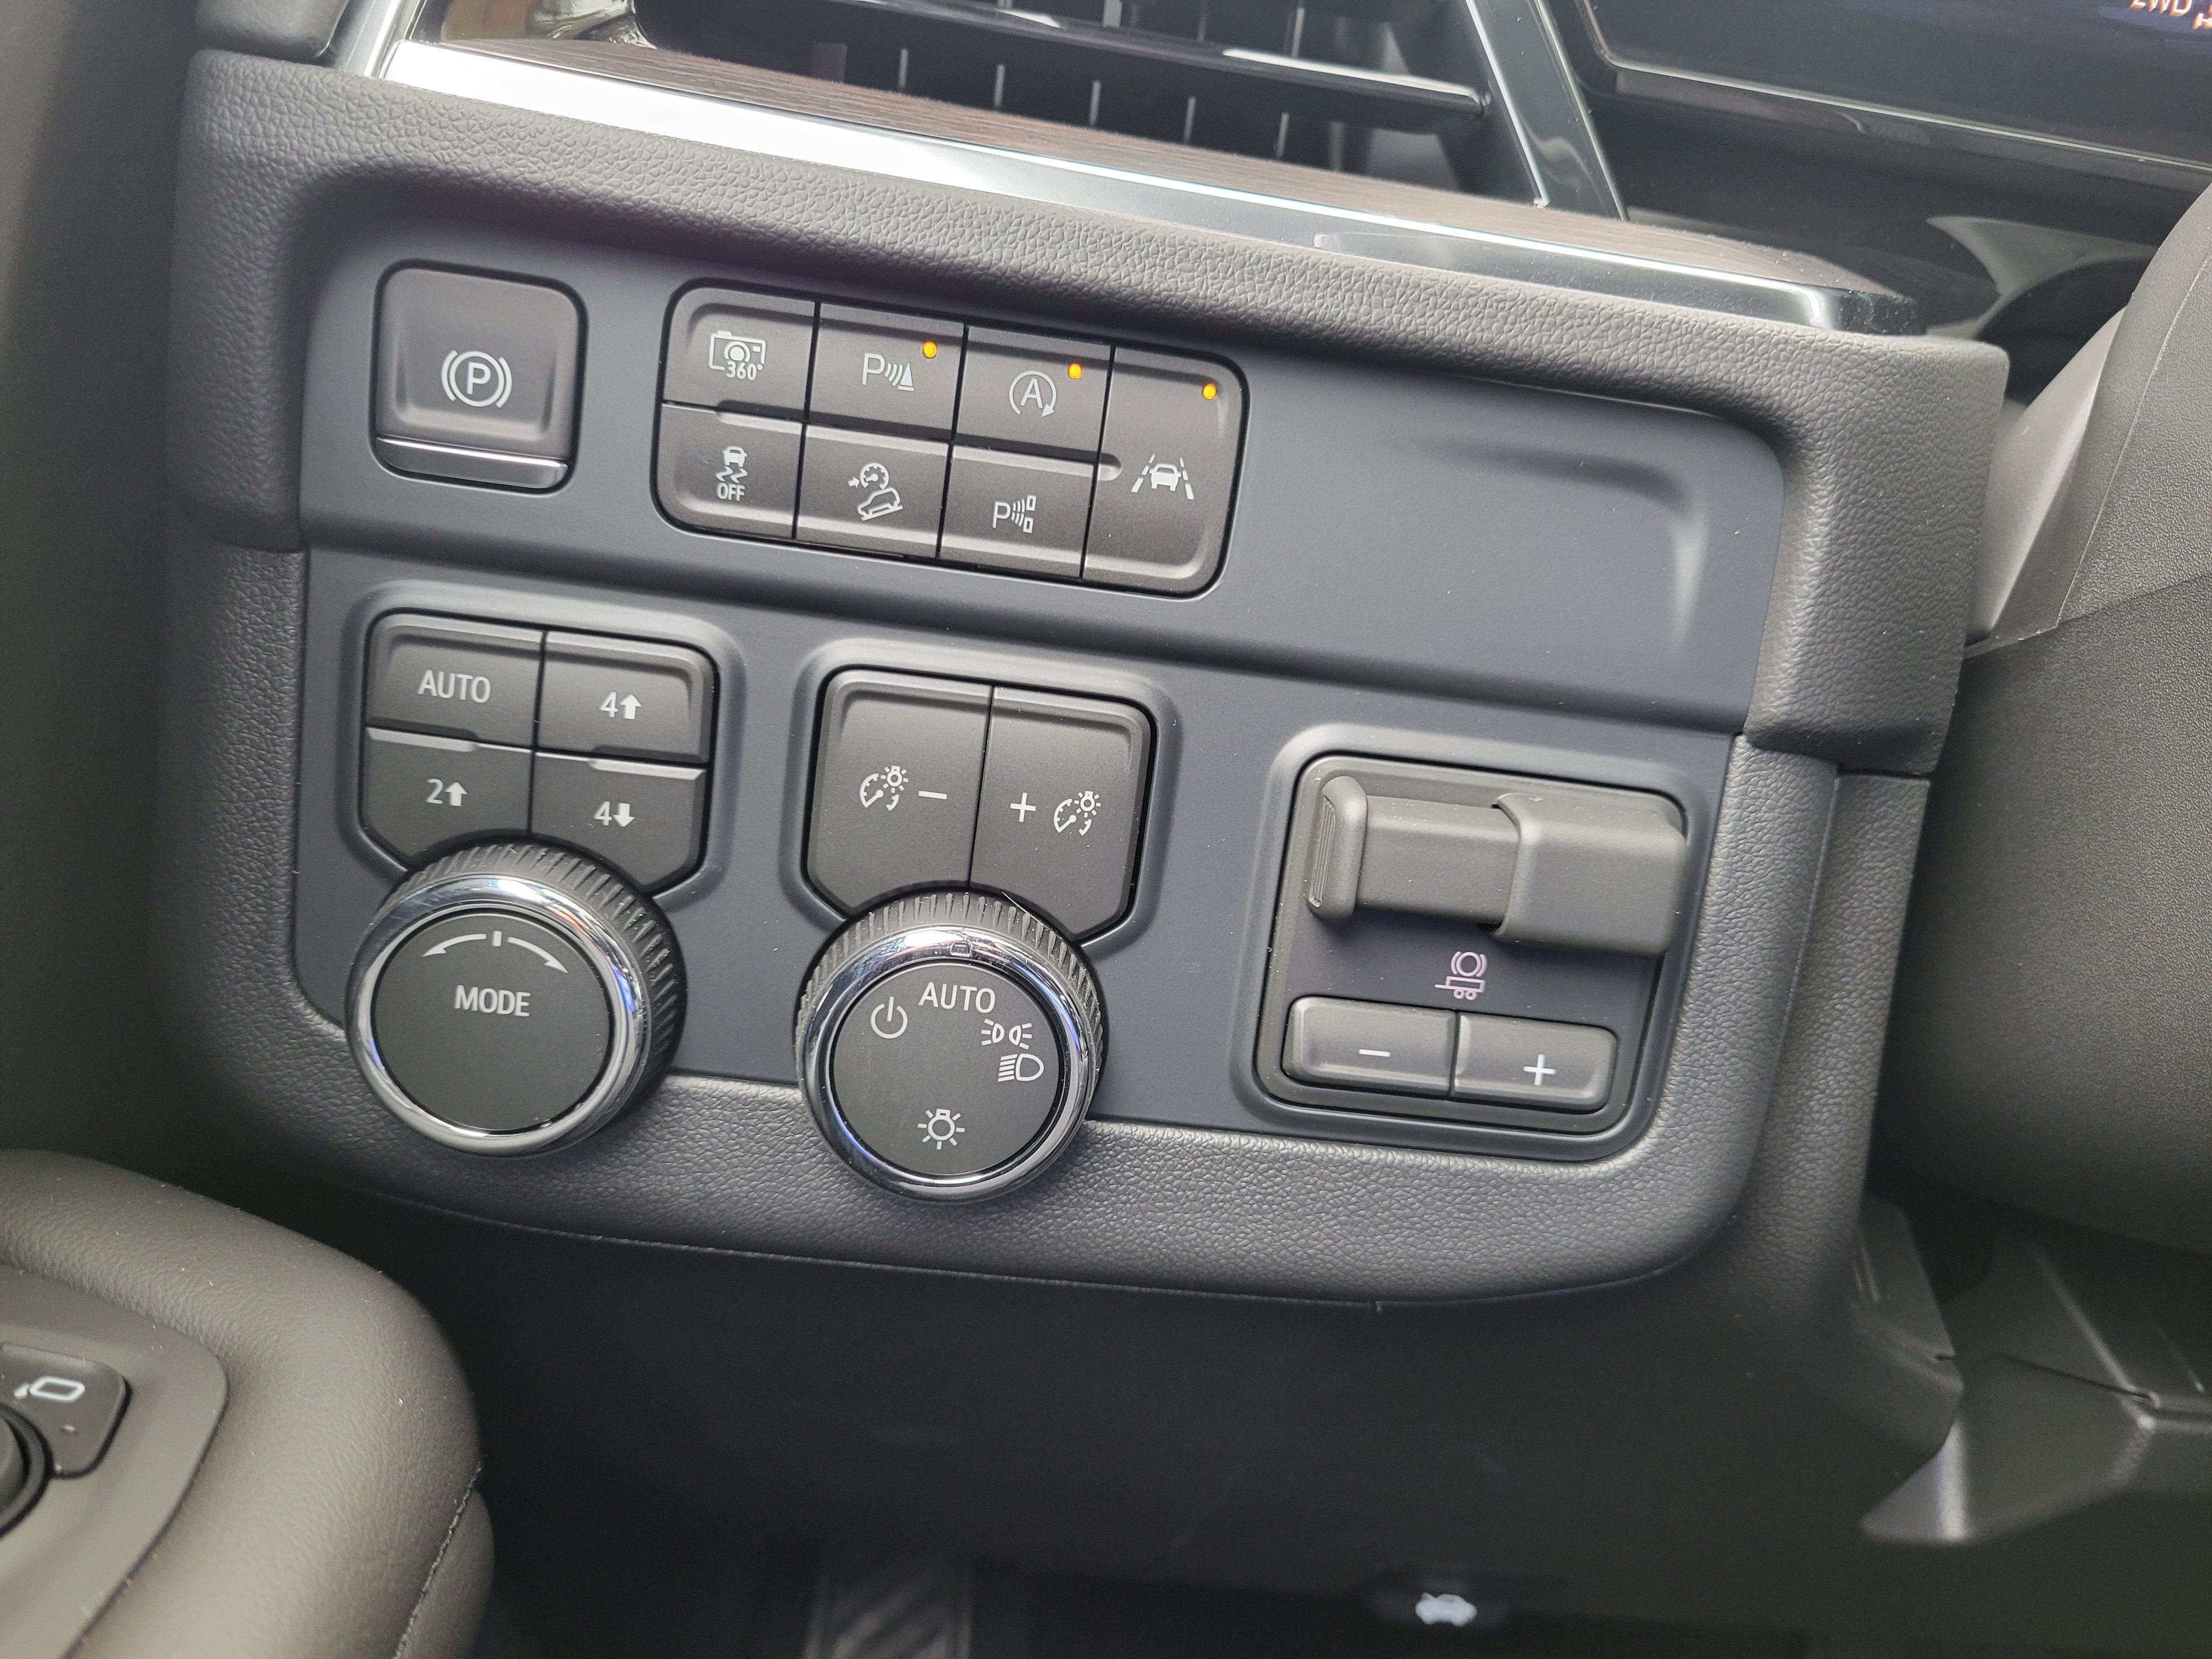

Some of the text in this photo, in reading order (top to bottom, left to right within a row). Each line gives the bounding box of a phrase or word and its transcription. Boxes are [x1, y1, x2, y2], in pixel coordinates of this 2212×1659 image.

[467, 362, 491, 395] P
[862, 353, 885, 385] P
[1020, 377, 1043, 408] A
[716, 482, 746, 501] OFF
[992, 501, 1011, 529] P
[417, 669, 492, 703] AUTO
[600, 692, 618, 718] 4
[425, 778, 444, 804] 2
[594, 800, 612, 826] 4
[454, 984, 531, 1017] MODE
[918, 981, 996, 1013] AUTO
